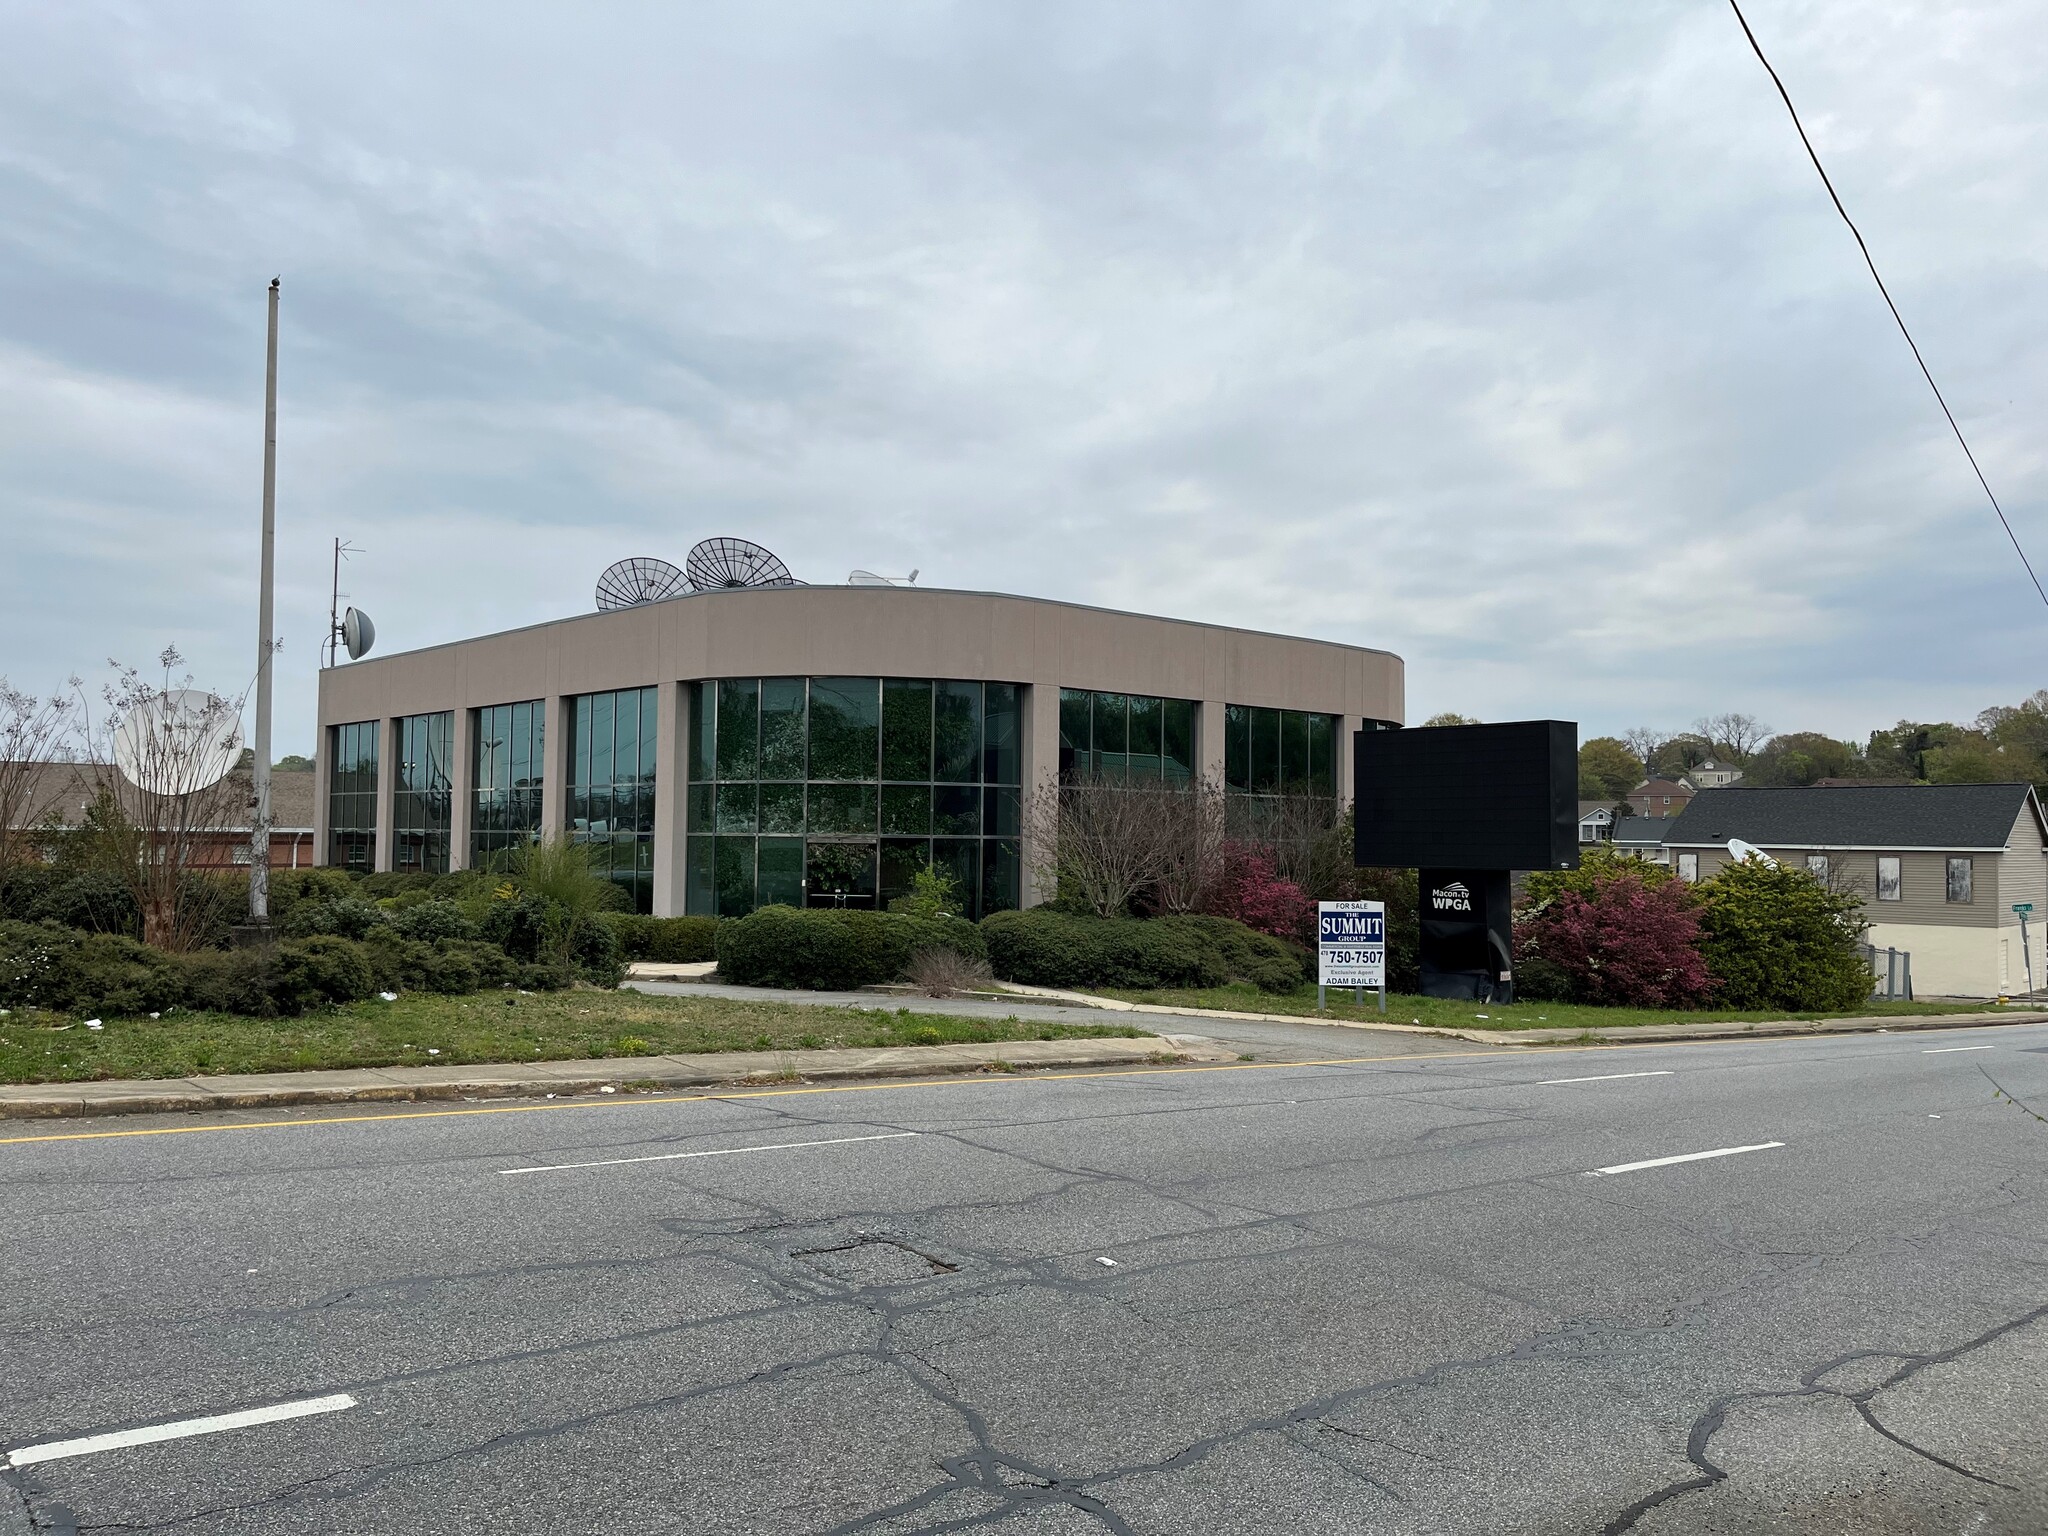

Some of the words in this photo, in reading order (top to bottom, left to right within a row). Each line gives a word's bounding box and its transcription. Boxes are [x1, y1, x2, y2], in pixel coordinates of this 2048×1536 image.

[1432, 889, 1470, 898] Macon.tv
[1432, 898, 1471, 911] WPGA
[1321, 917, 1382, 934] SUMMIT
[1330, 951, 1383, 963] 750-7507
